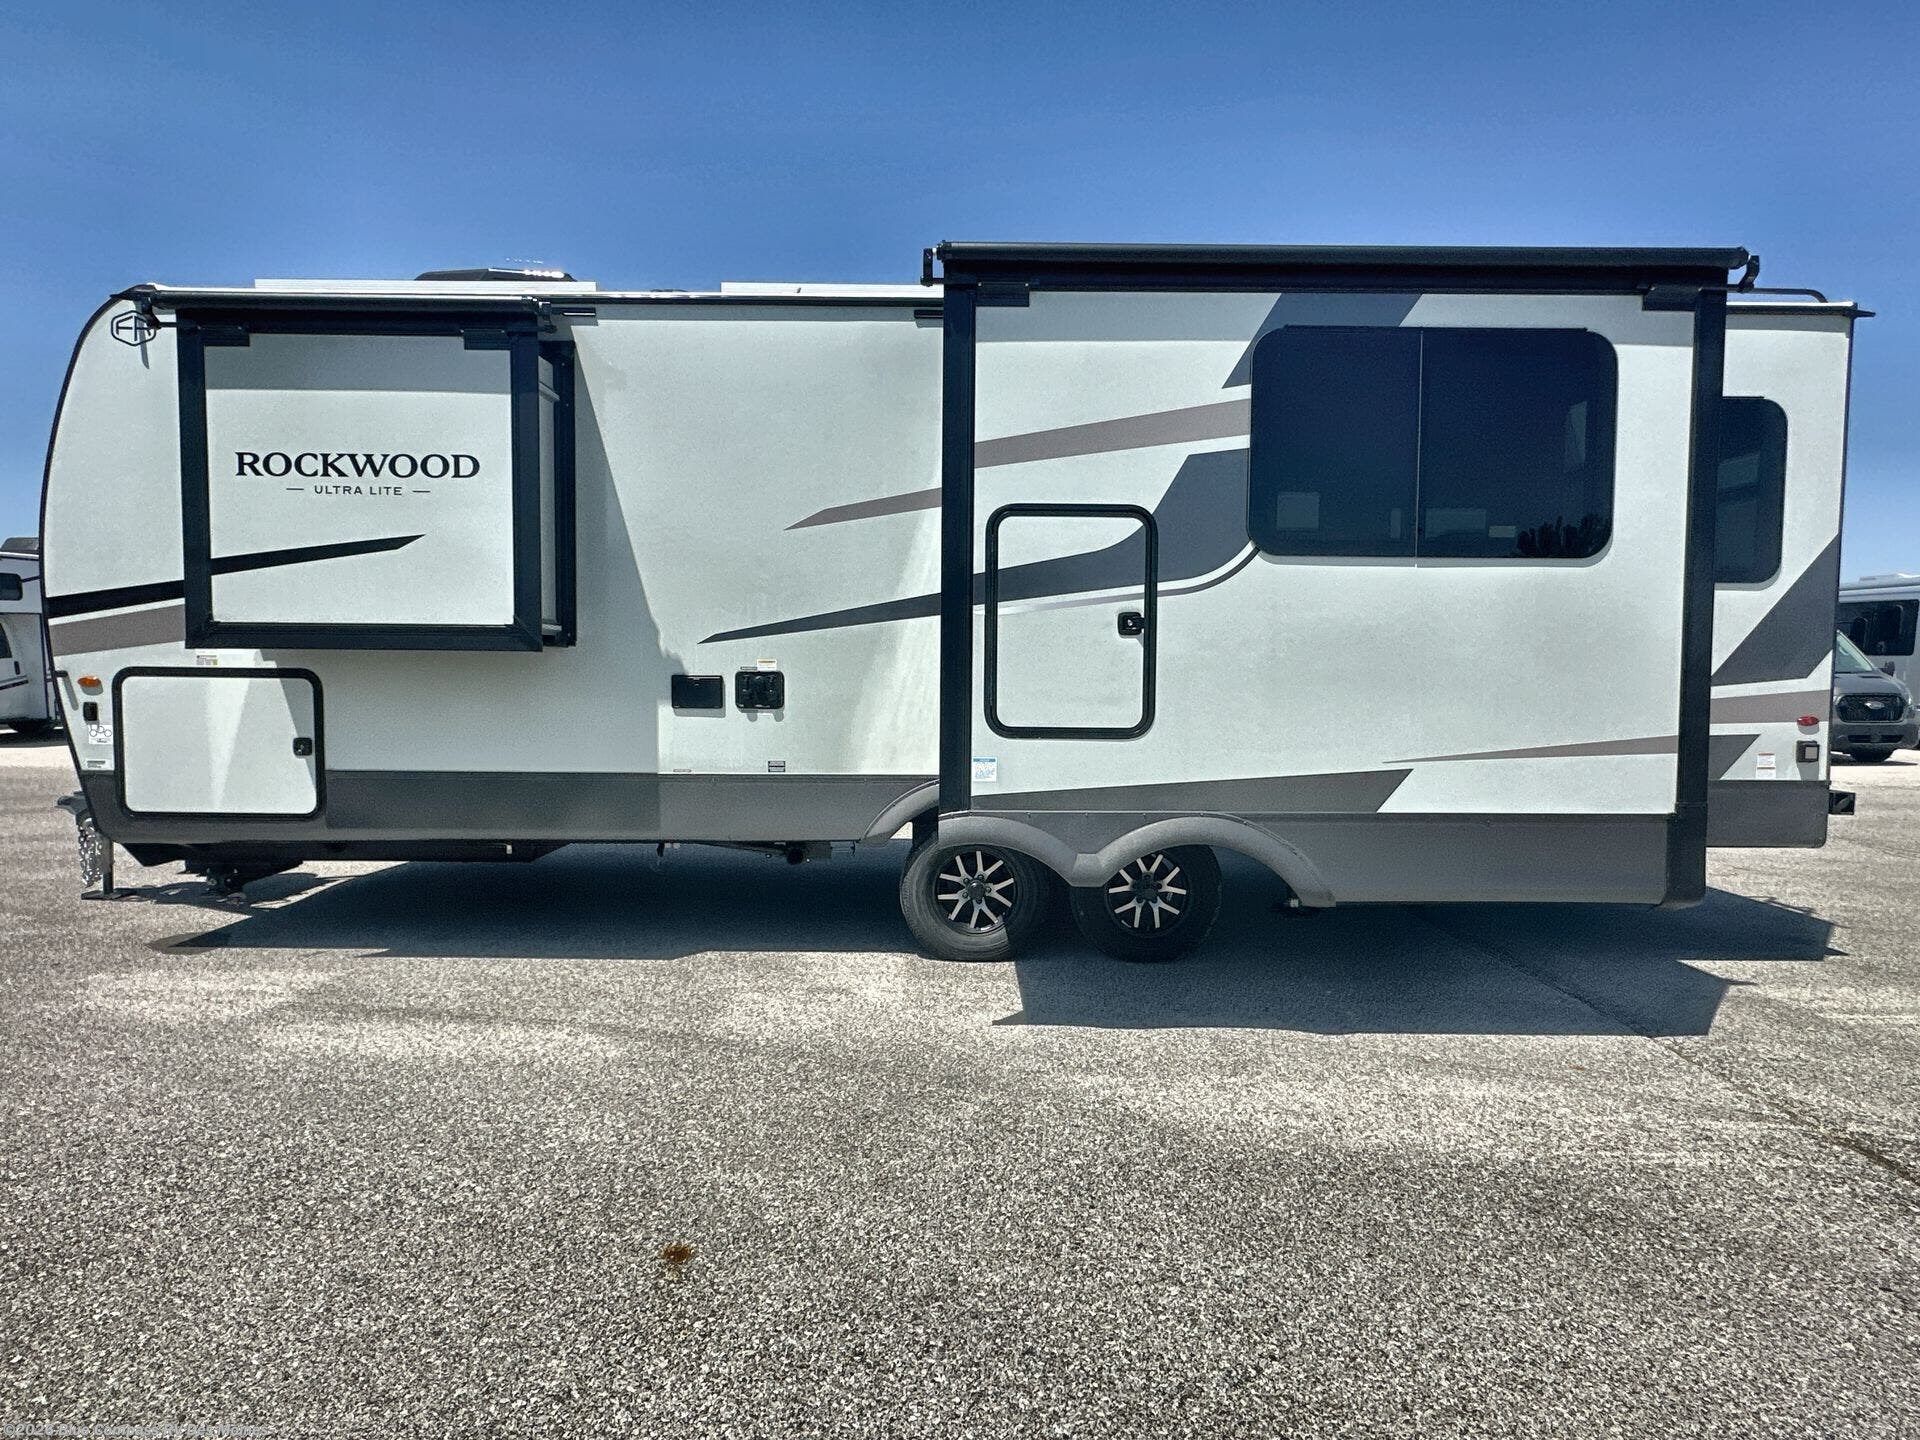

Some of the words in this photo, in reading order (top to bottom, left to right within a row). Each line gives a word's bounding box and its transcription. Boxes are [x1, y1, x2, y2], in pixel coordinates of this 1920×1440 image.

[235, 451, 480, 478] ROCKWOOD
[314, 485, 363, 495] ULTRA
[369, 486, 402, 496] LITE
